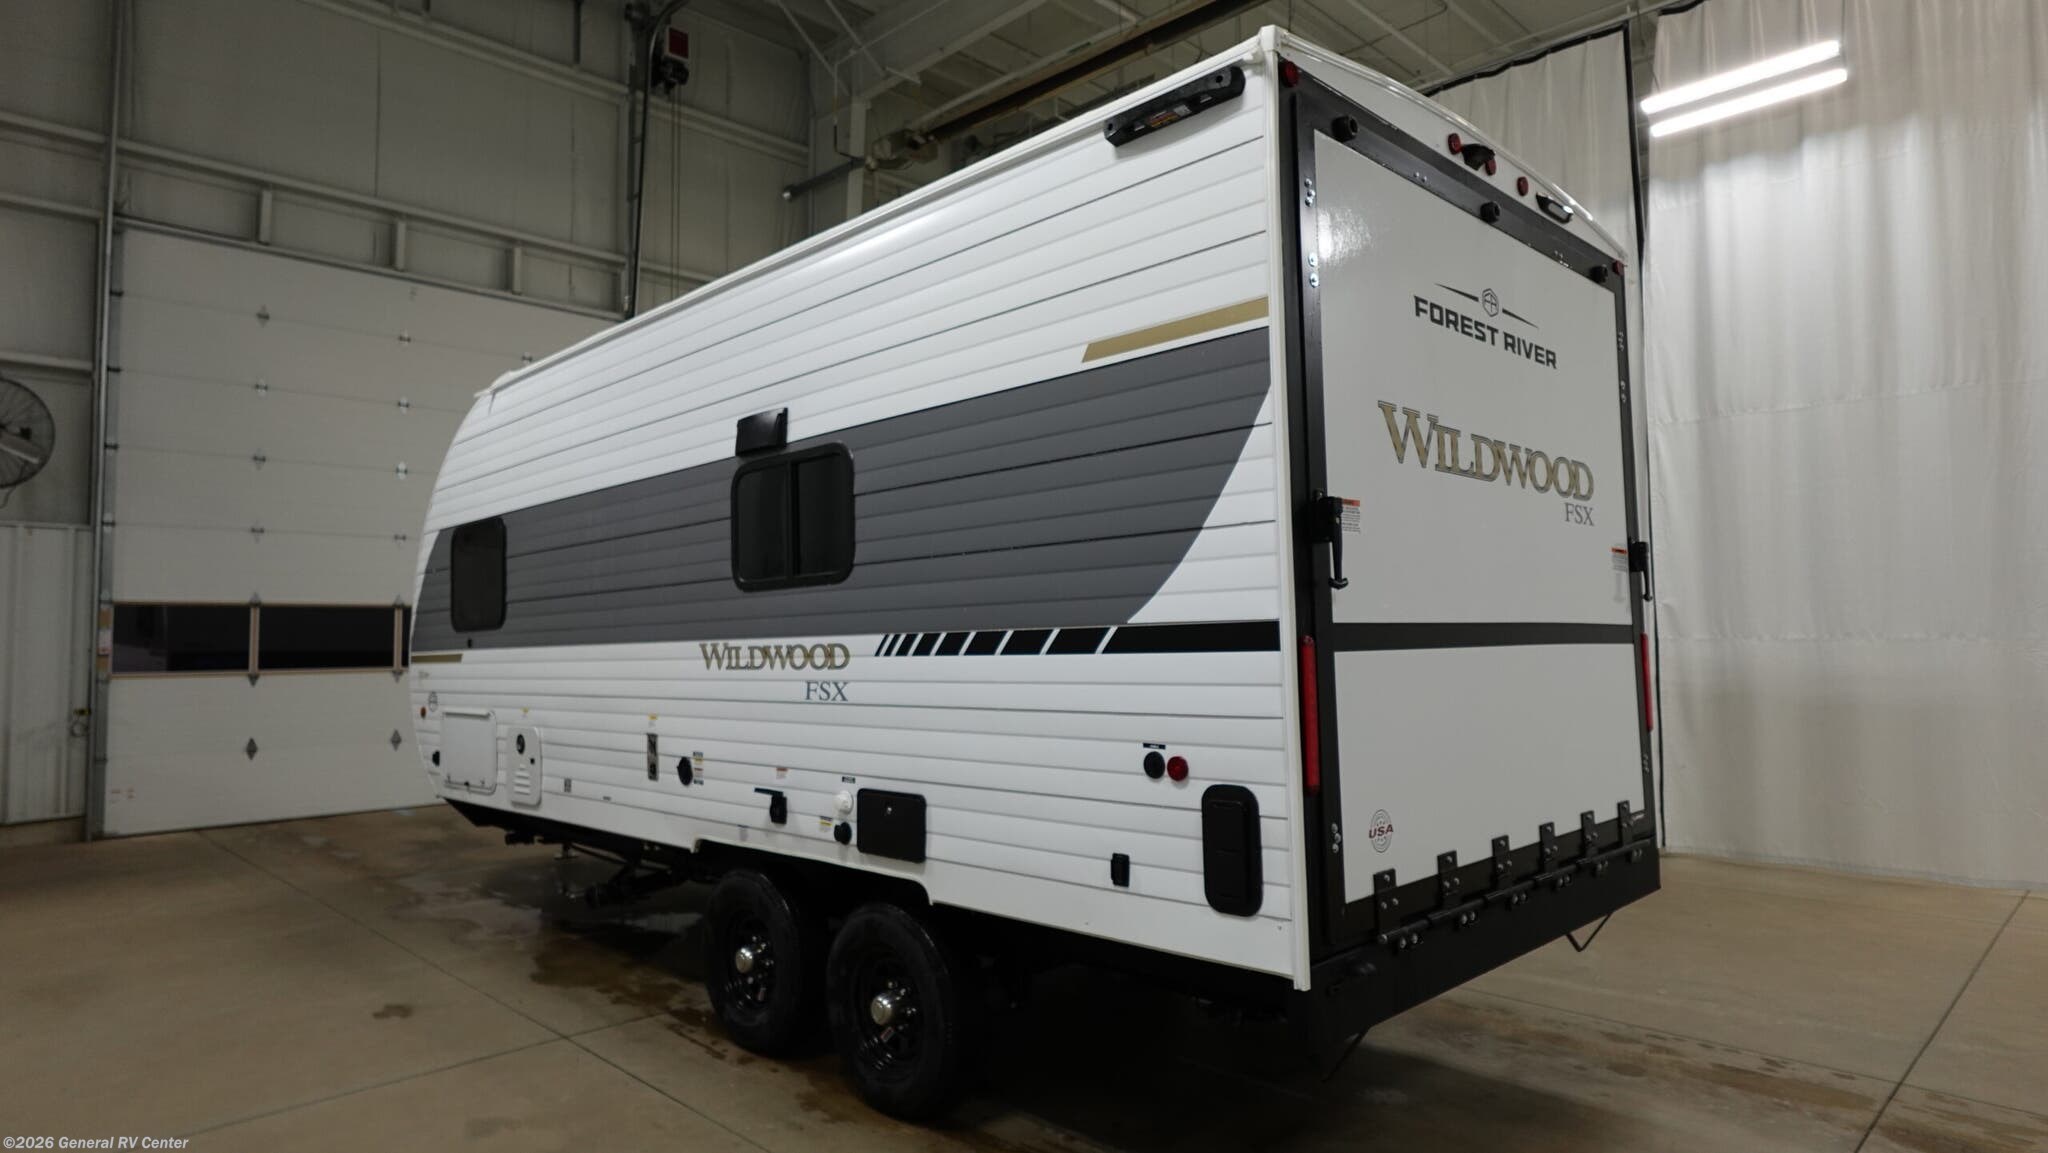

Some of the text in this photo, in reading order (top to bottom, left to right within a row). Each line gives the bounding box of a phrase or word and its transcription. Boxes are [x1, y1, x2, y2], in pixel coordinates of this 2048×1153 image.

[1414, 295, 1557, 370] FOREST RIVER
[1565, 503, 1595, 526] FSX
[805, 680, 849, 702] FSX
[1369, 824, 1394, 838] USA
